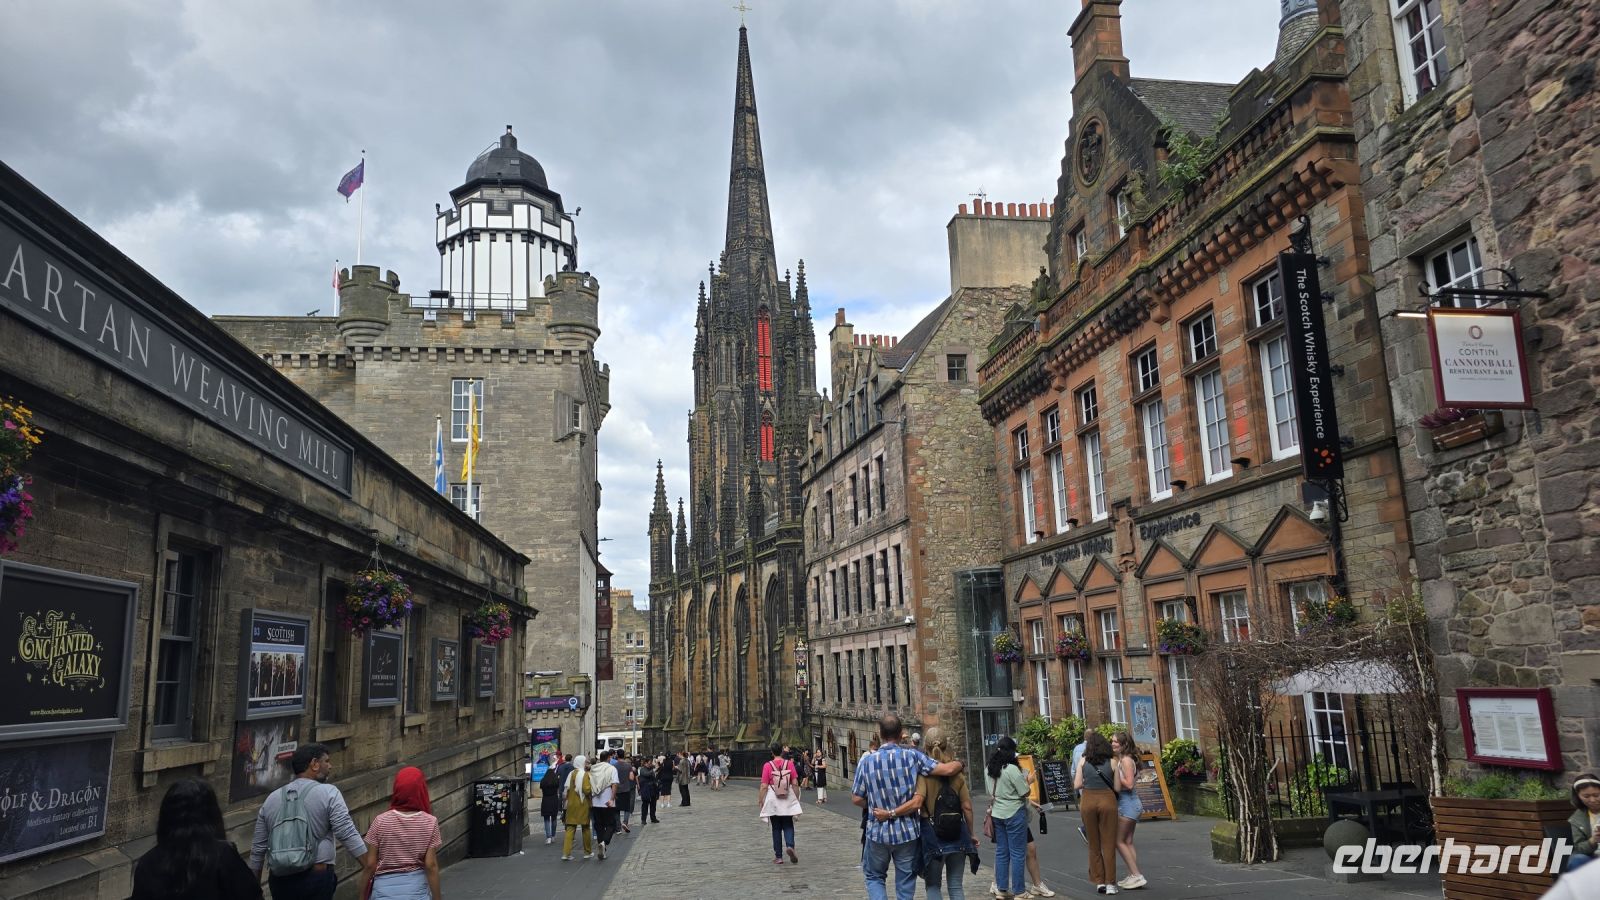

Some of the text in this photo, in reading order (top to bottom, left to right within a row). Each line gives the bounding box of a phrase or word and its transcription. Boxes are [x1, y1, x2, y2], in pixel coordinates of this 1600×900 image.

[1296, 268, 1325, 439] The Scotch Whisky Experience
[1445, 358, 1515, 368] CANNONBALL
[1458, 348, 1499, 356] CONTINI
[169, 343, 289, 450] WEAVING
[298, 430, 339, 480] MILL
[1139, 511, 1202, 541] Experience
[1040, 553, 1054, 568] The
[1081, 536, 1113, 557] Whisky
[267, 627, 295, 641] SCOTTISH
[52, 652, 102, 686] GALAXY
[0, 784, 102, 814] OLF & DRAGON
[87, 814, 97, 828] B1
